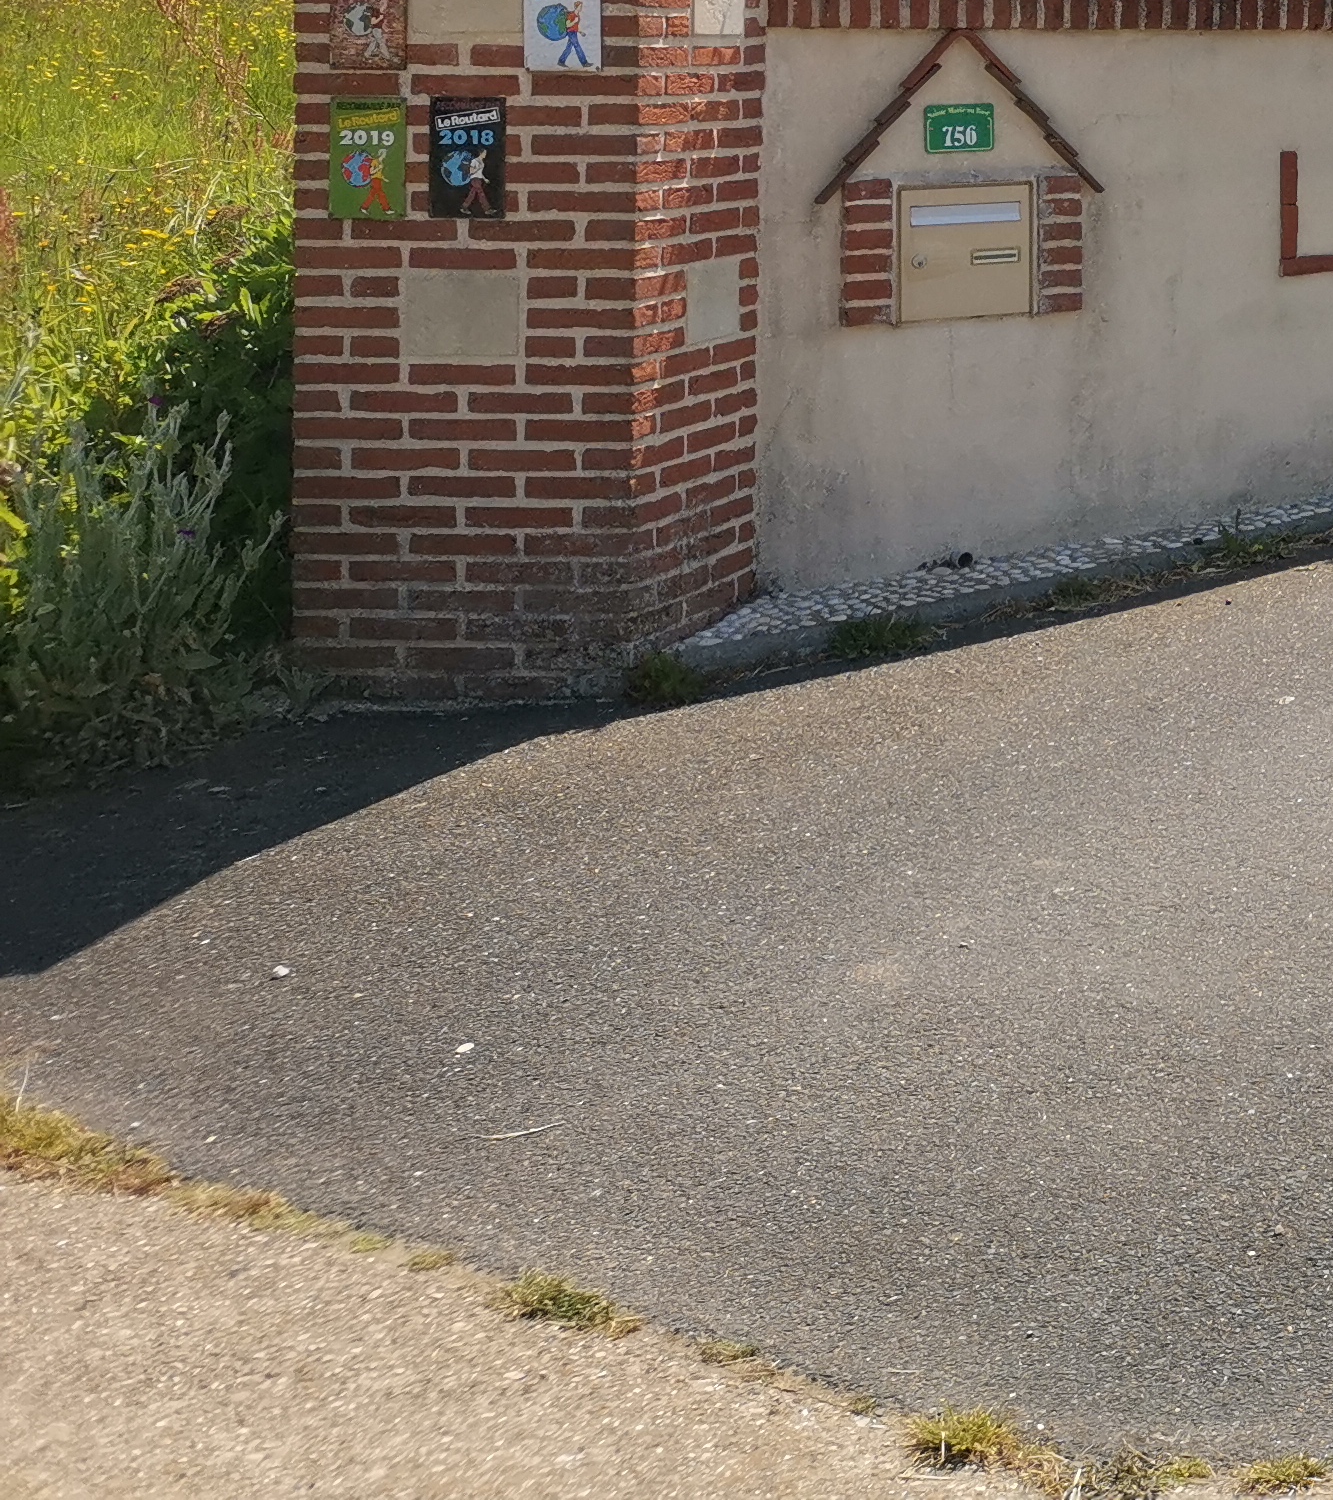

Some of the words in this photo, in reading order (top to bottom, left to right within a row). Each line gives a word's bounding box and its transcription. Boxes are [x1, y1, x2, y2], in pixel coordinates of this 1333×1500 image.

[450, 110, 497, 127] Routard
[338, 129, 395, 146] 2019
[438, 129, 494, 146] 2018
[942, 125, 977, 146] 756
